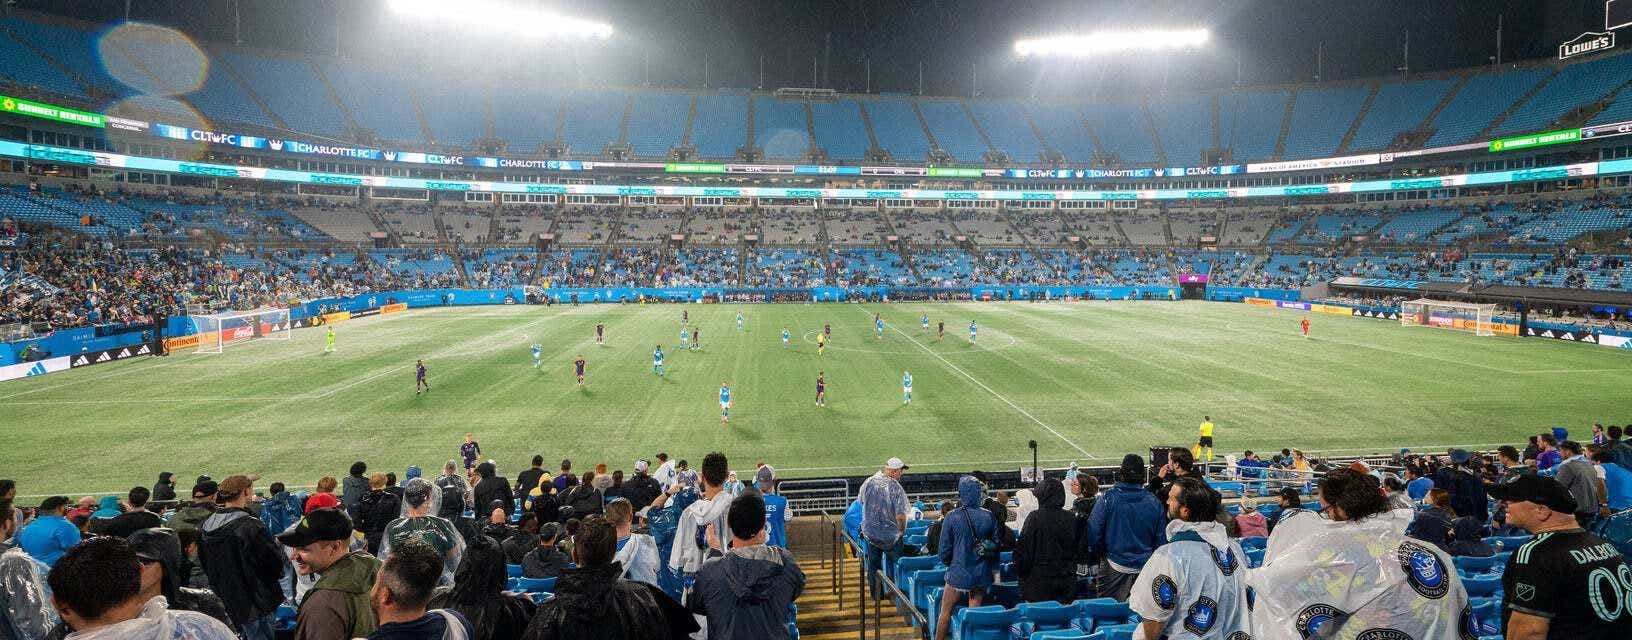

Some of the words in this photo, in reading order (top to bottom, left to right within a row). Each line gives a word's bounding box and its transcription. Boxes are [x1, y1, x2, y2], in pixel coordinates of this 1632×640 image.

[1565, 37, 1609, 56] LOWE'S
[299, 143, 356, 157] CHARLOTTE
[357, 149, 370, 158] FC
[500, 159, 546, 168] CHARLOTTE
[1094, 169, 1134, 177] CHARLOTTE
